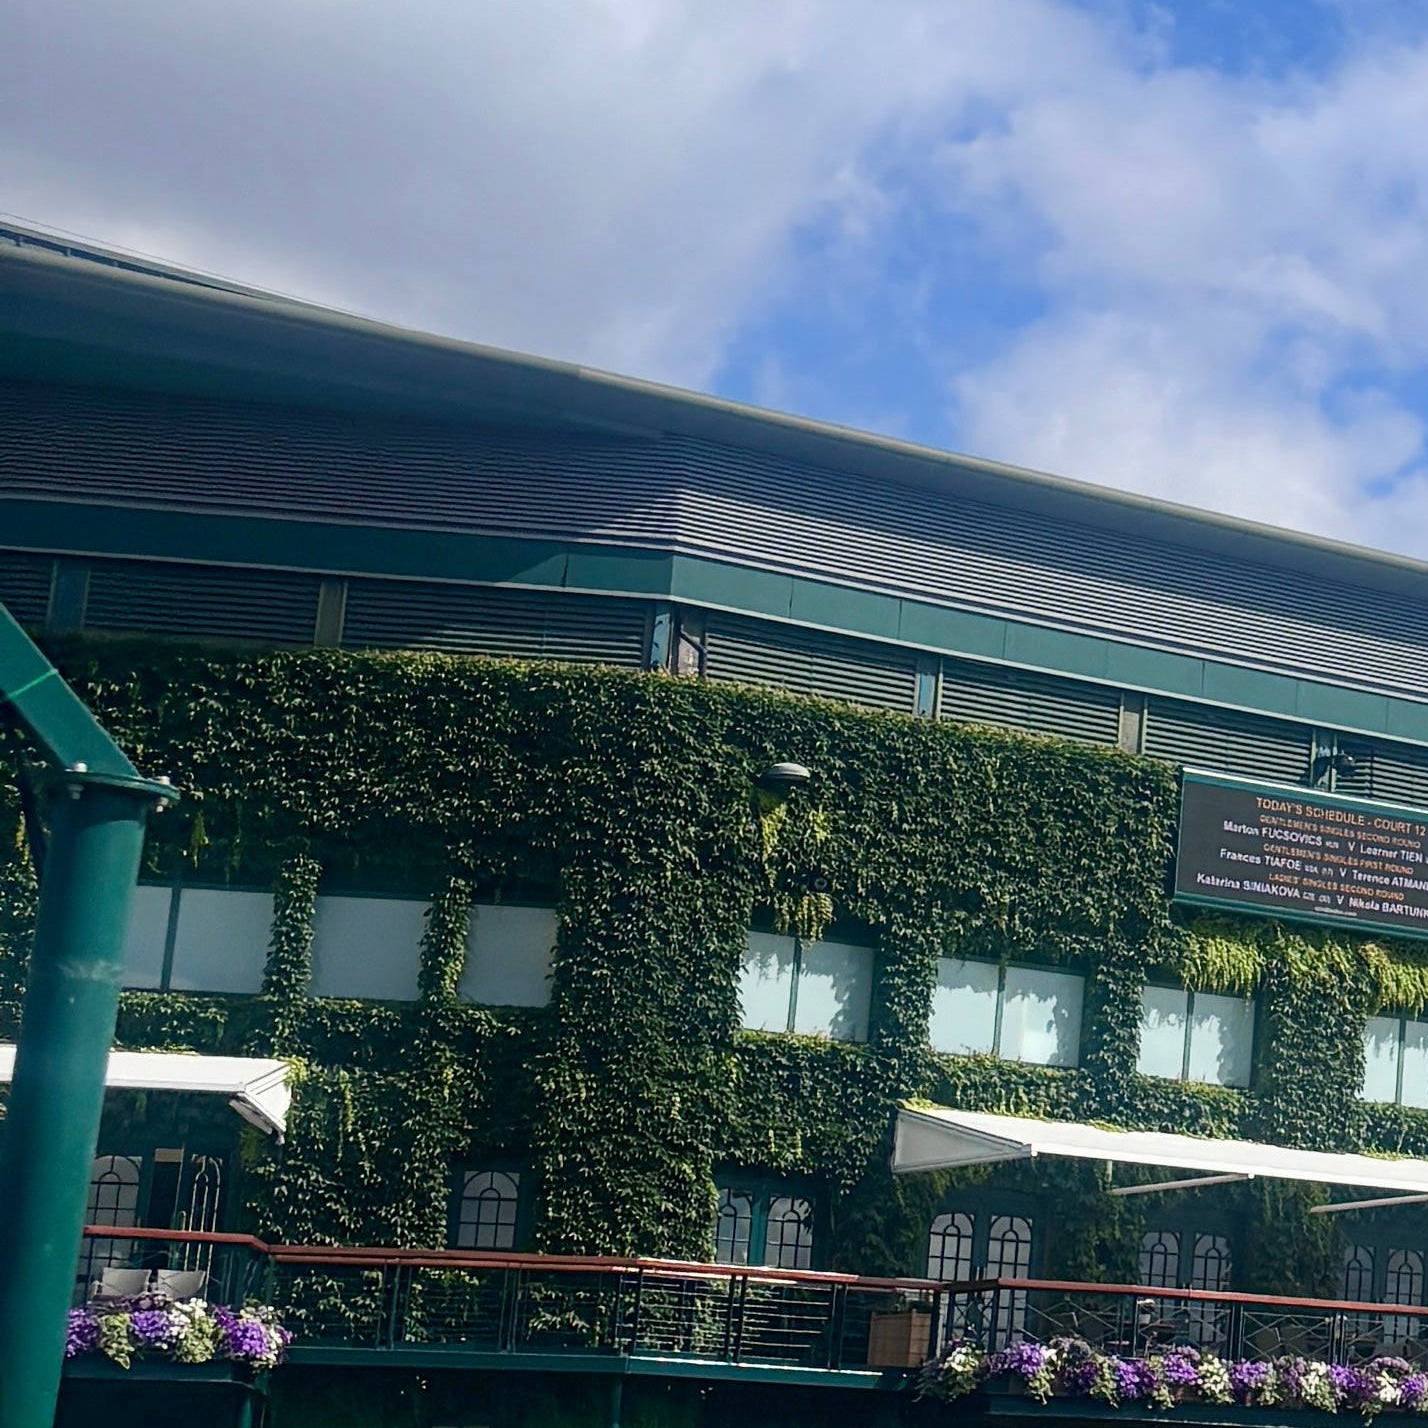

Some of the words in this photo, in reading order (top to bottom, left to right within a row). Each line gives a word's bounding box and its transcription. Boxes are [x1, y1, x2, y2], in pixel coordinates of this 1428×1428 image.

[1256, 797, 1303, 815] TODAY'S
[1306, 805, 1365, 826] SCHEDULE
[1374, 818, 1412, 834] COURT
[1414, 825, 1427, 836] 12
[1262, 827, 1323, 846] FUCSOVICS
[1347, 841, 1356, 852] V
[1360, 843, 1397, 859] Learner
[1400, 850, 1423, 864] TIEN
[1357, 831, 1390, 844] SECOND
[1392, 837, 1421, 849] ROUND
[1264, 855, 1303, 872] TIAFOE
[1339, 868, 1347, 878] V
[1352, 870, 1391, 885] Terence
[1360, 859, 1383, 870] FIRST
[1385, 864, 1415, 876] ROUND
[1243, 880, 1302, 899] SINIAKOVA
[1336, 895, 1345, 905] V
[1349, 897, 1380, 911] Nikola
[1302, 877, 1338, 891] SINGLES
[1340, 883, 1374, 898] SECOND
[1376, 889, 1406, 902] ROUND
